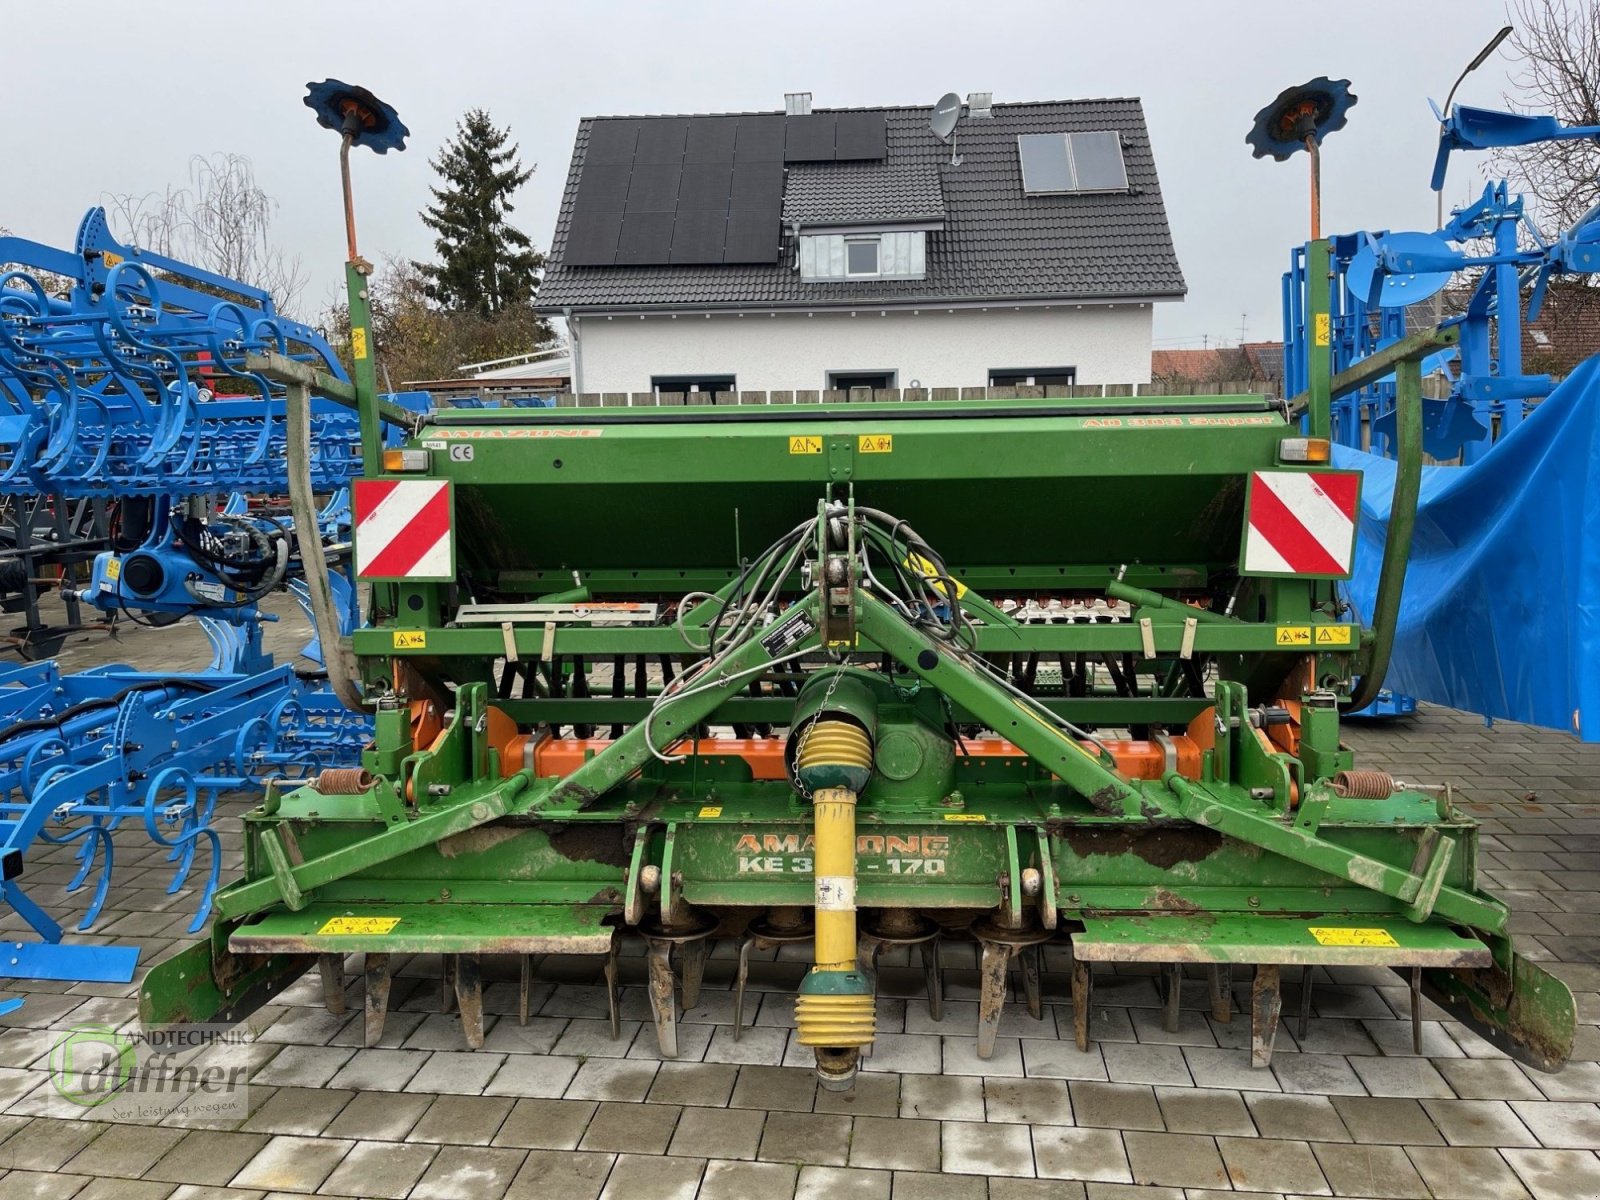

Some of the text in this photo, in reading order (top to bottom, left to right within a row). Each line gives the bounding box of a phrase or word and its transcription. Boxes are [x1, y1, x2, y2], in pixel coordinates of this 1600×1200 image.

[1188, 416, 1274, 426] Super
[429, 428, 604, 438] AMAZONE
[736, 834, 949, 856] AMAONE
[739, 857, 783, 873] KE
[886, 858, 945, 875] 170
